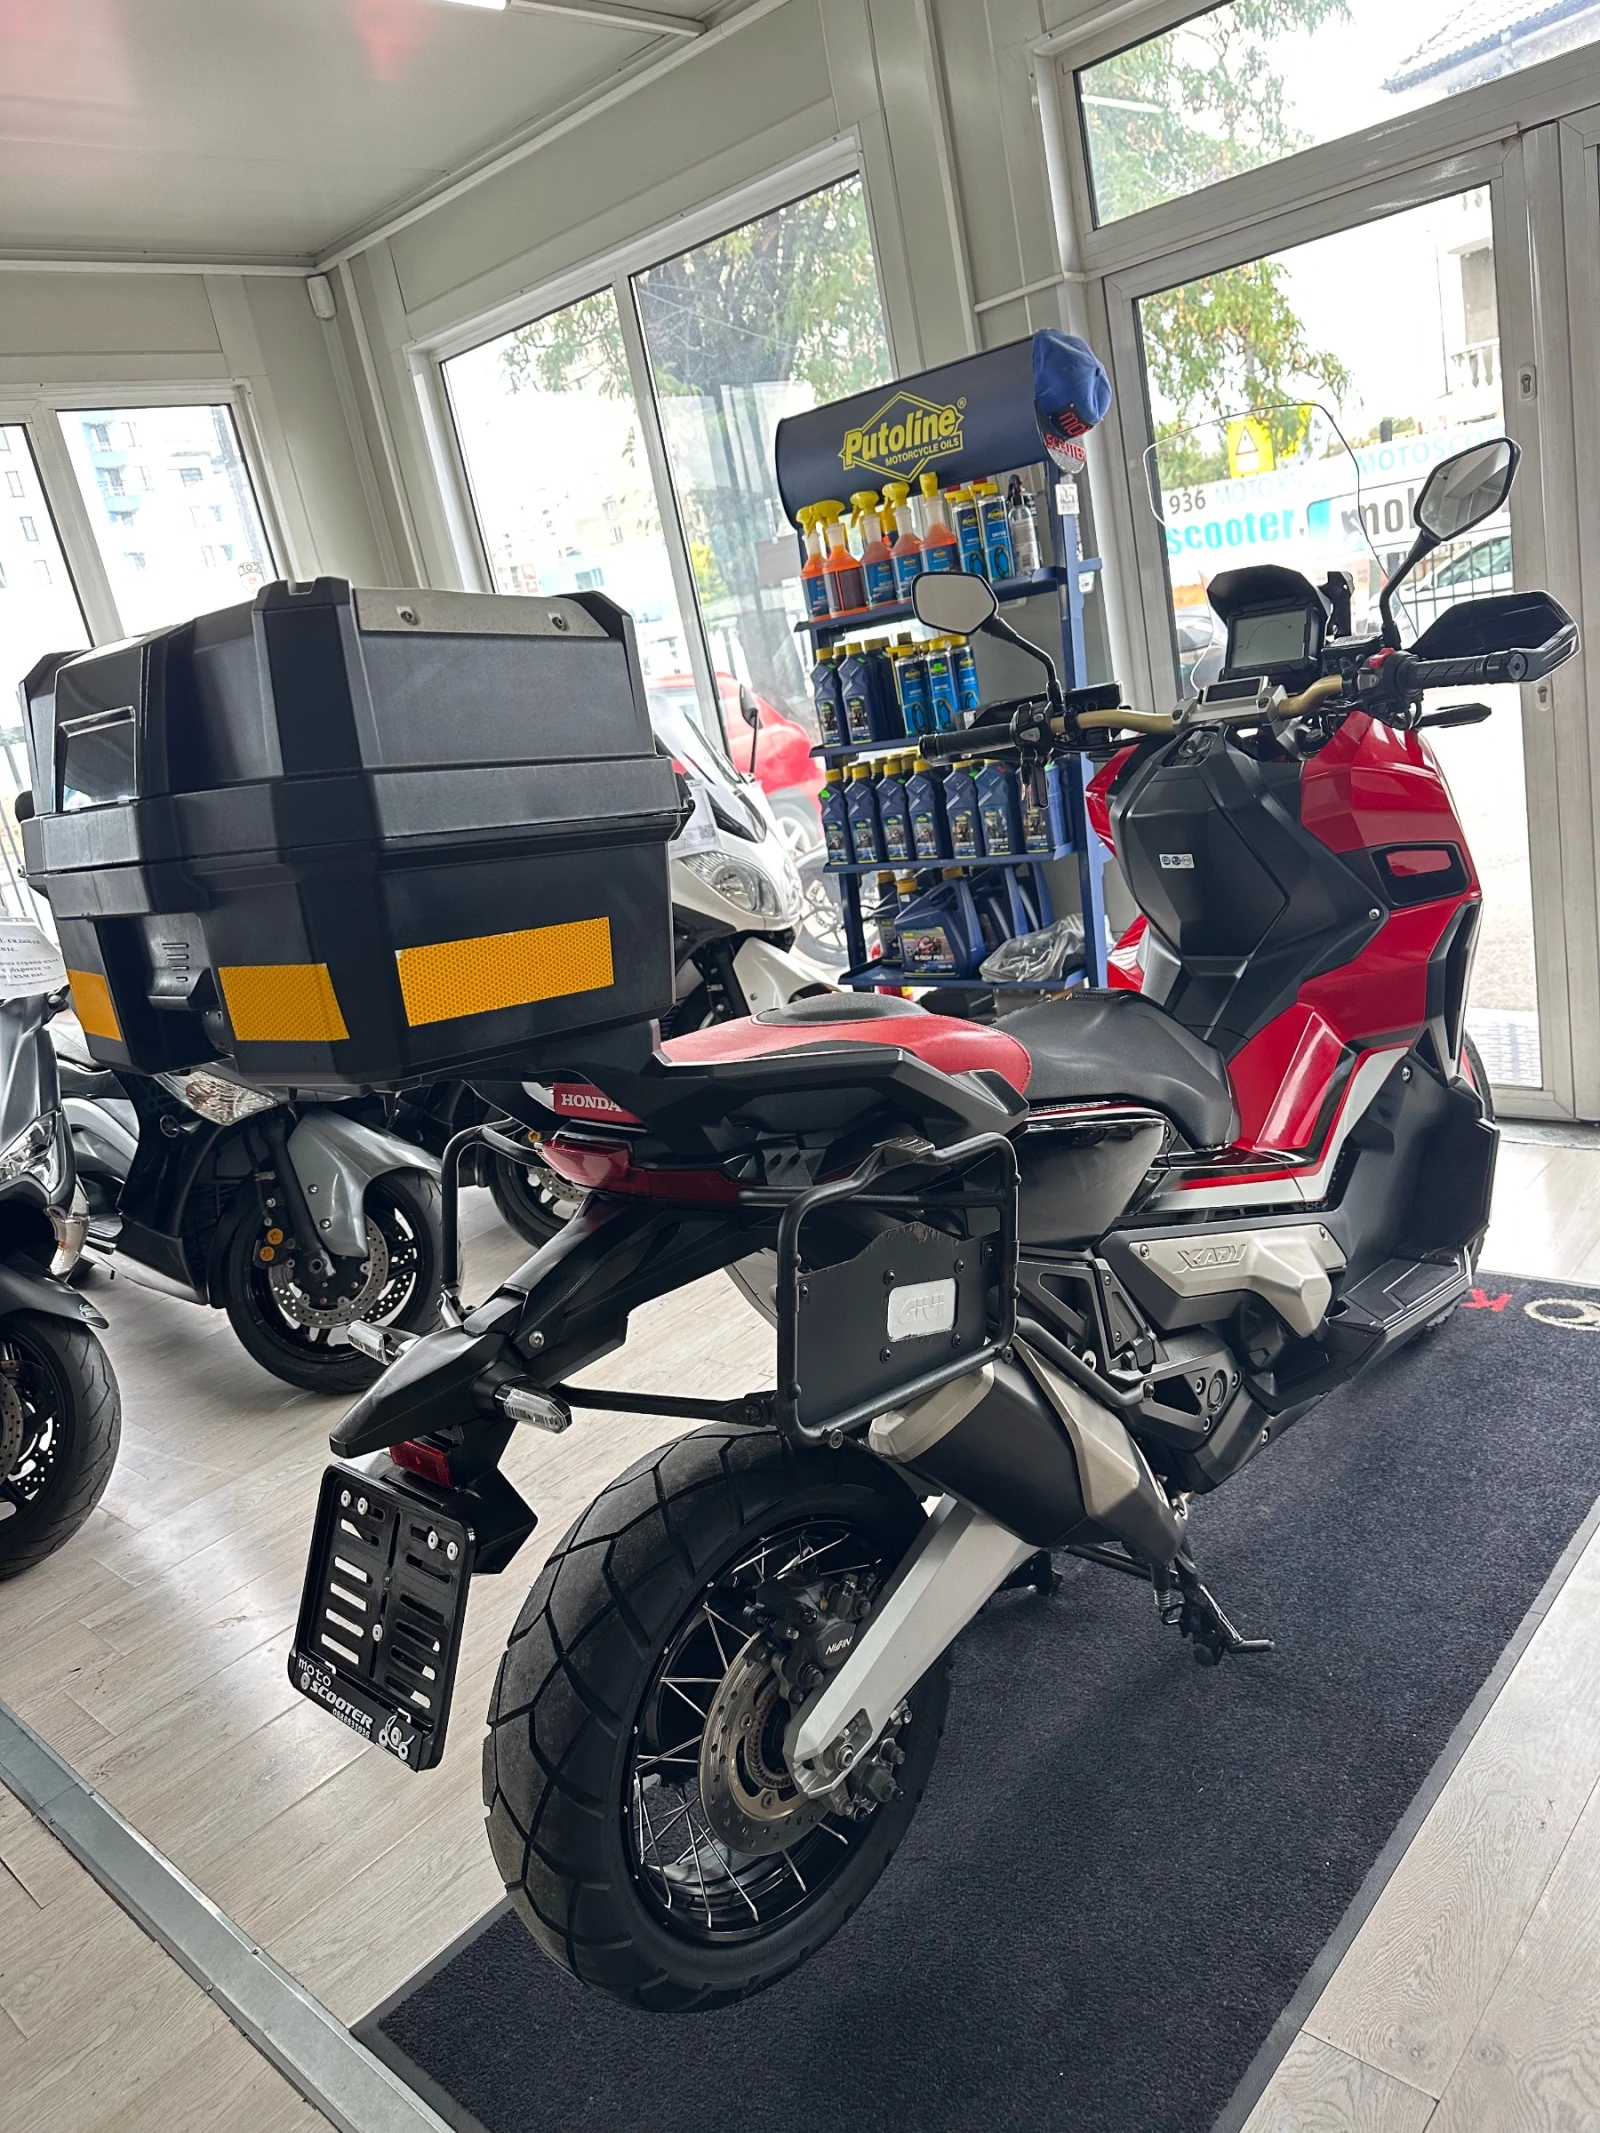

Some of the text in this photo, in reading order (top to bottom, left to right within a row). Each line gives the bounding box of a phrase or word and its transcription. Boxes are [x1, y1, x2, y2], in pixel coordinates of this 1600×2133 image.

[845, 408, 956, 466] Putoline
[885, 437, 960, 467] MOTORCYCLE OILS
[1169, 489, 1206, 515] 936
[561, 1093, 623, 1113] HONDA
[310, 1680, 374, 1730] SCOOTER
